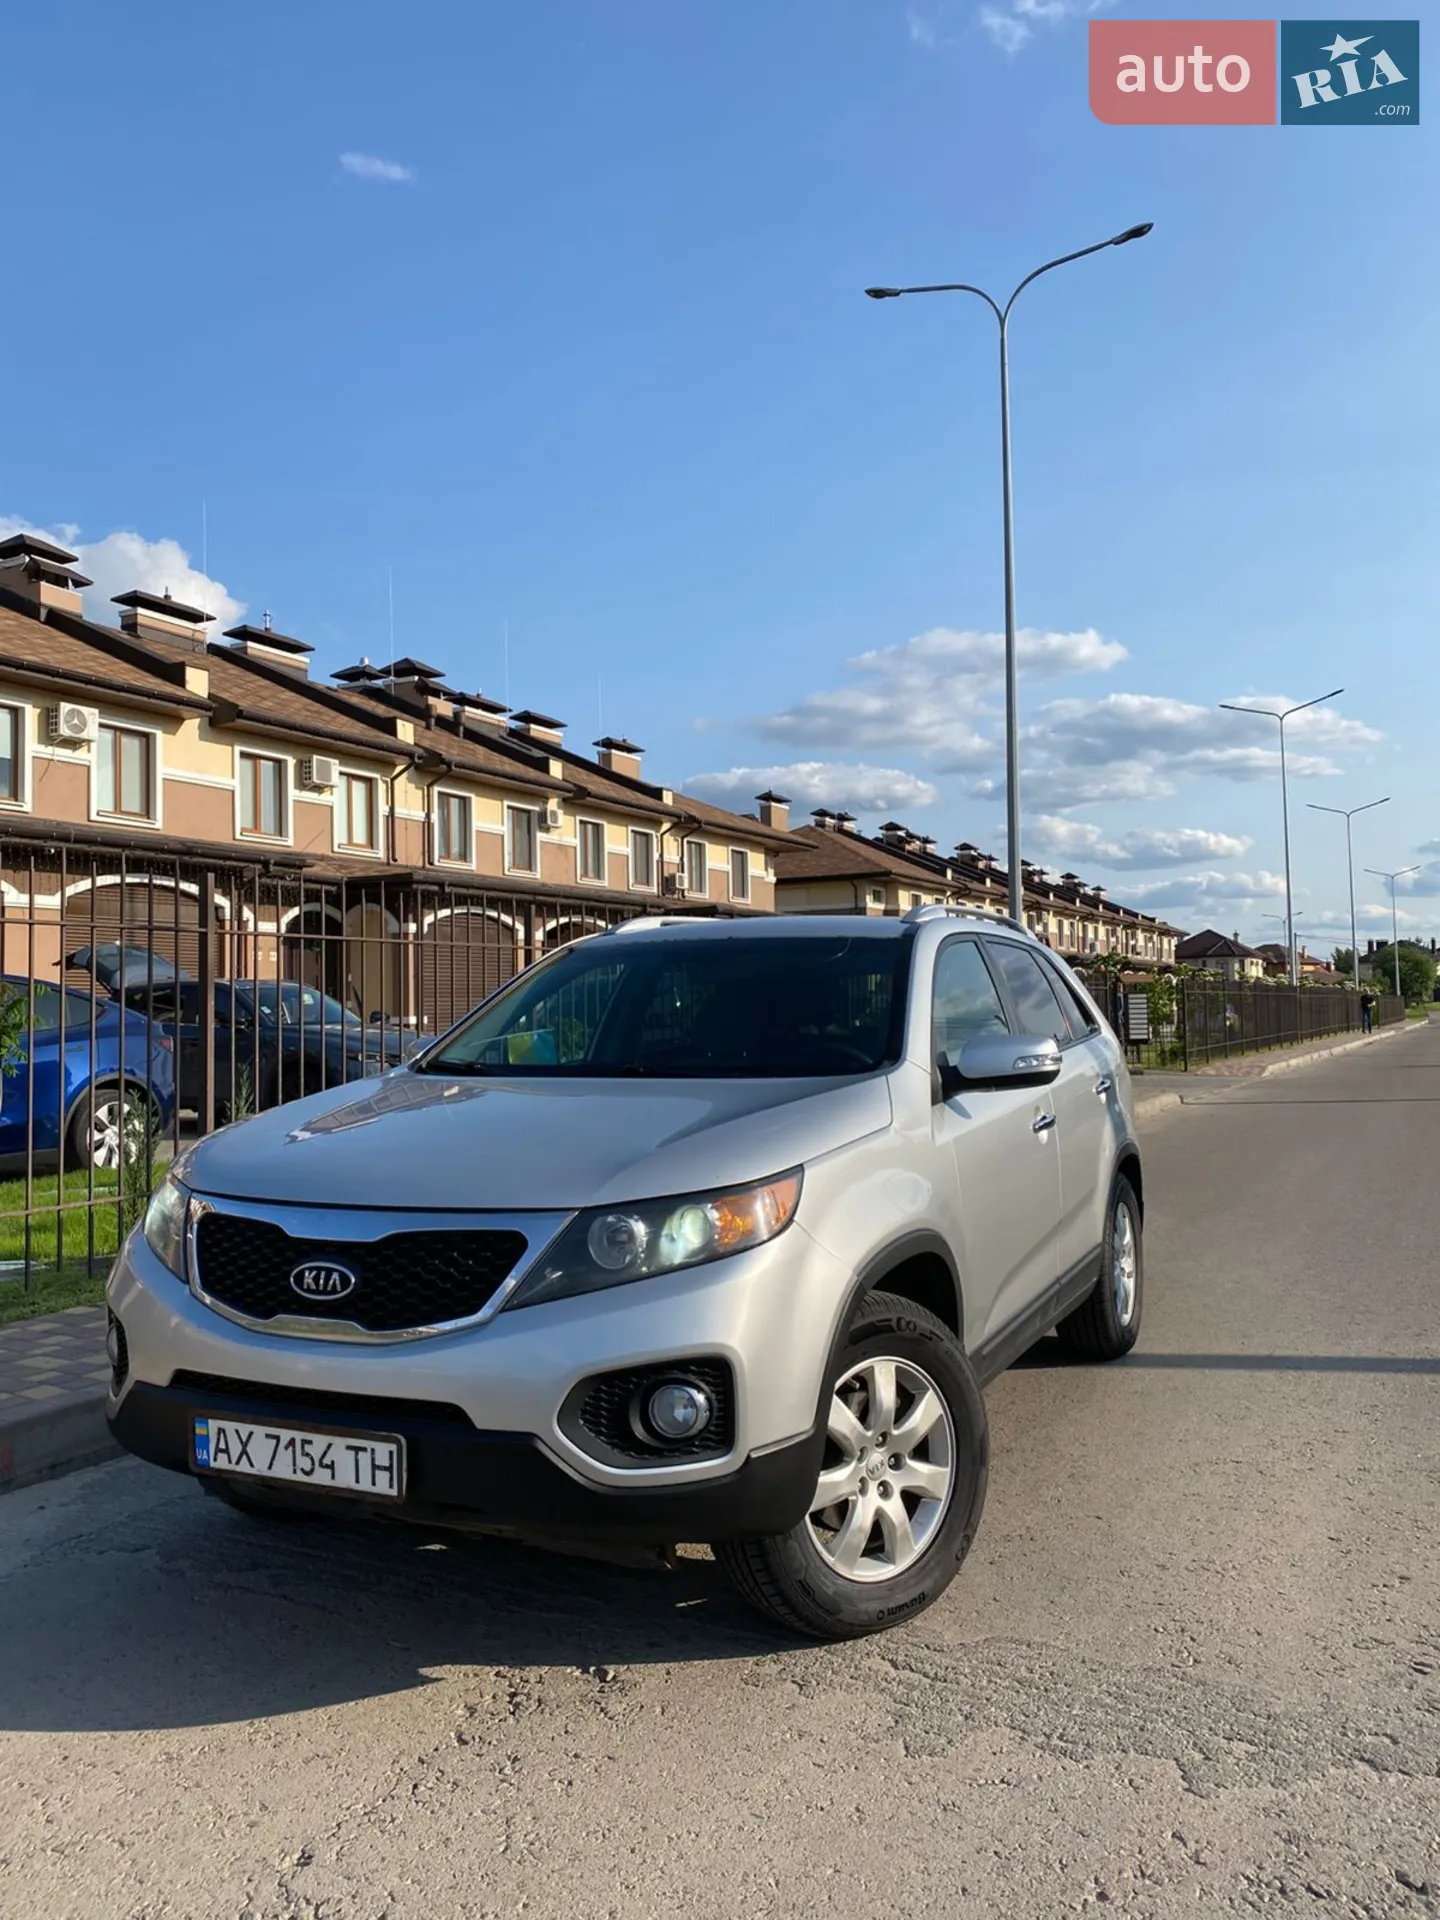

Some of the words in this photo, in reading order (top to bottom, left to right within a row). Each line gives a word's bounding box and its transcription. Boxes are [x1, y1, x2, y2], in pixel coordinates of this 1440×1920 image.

[303, 1269, 342, 1292] KIA
[196, 1448, 209, 1461] UA
[213, 1427, 255, 1469] AX
[265, 1433, 336, 1481] 7154
[345, 1445, 396, 1490] TH
